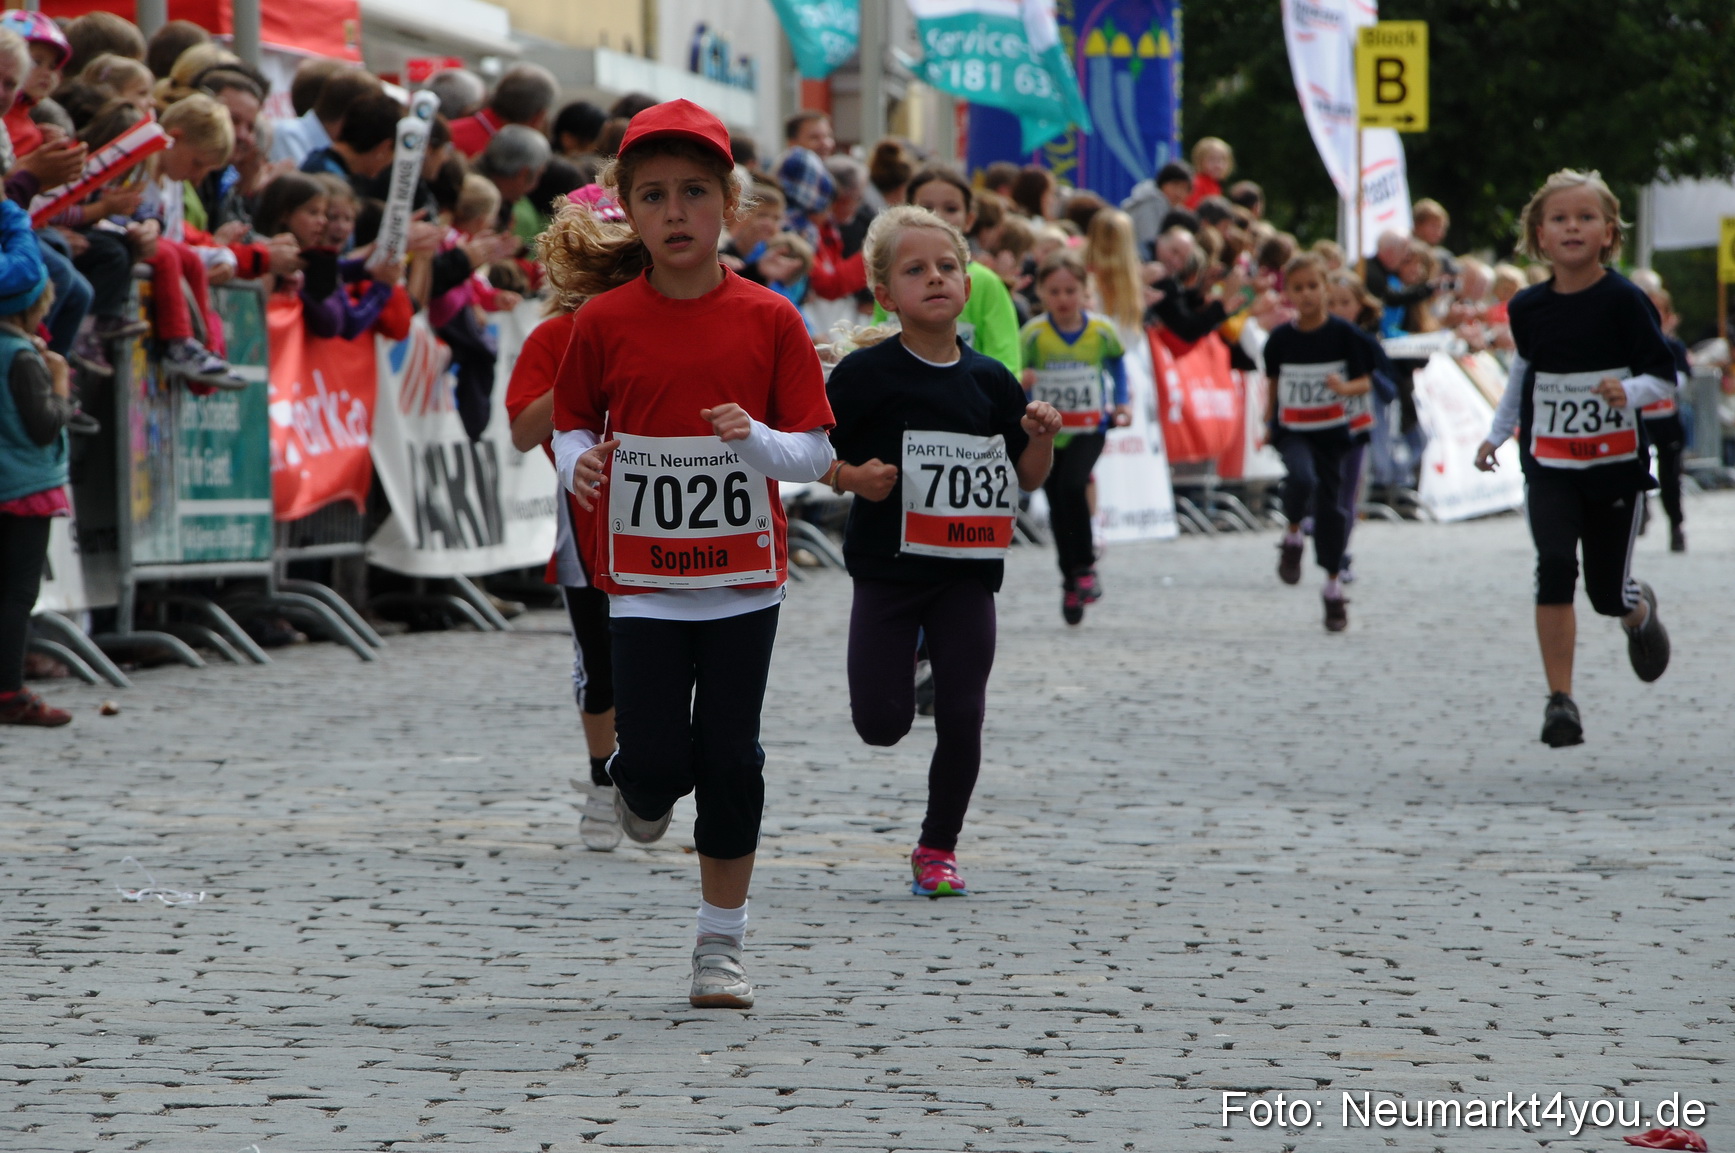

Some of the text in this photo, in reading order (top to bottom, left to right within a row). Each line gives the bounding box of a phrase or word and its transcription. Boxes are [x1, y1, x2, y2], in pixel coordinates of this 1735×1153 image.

[1363, 30, 1416, 46] Block
[1376, 57, 1407, 104] B
[1039, 386, 1092, 409] 7294
[1543, 400, 1623, 433] 7234
[614, 449, 740, 468] PARTL Neumarkt
[907, 444, 953, 458] PARTL
[1569, 442, 1597, 456] Ella
[921, 464, 1010, 509] 7032
[624, 471, 752, 530] 7026
[948, 523, 995, 542] Mona
[650, 545, 728, 574] Sophia
